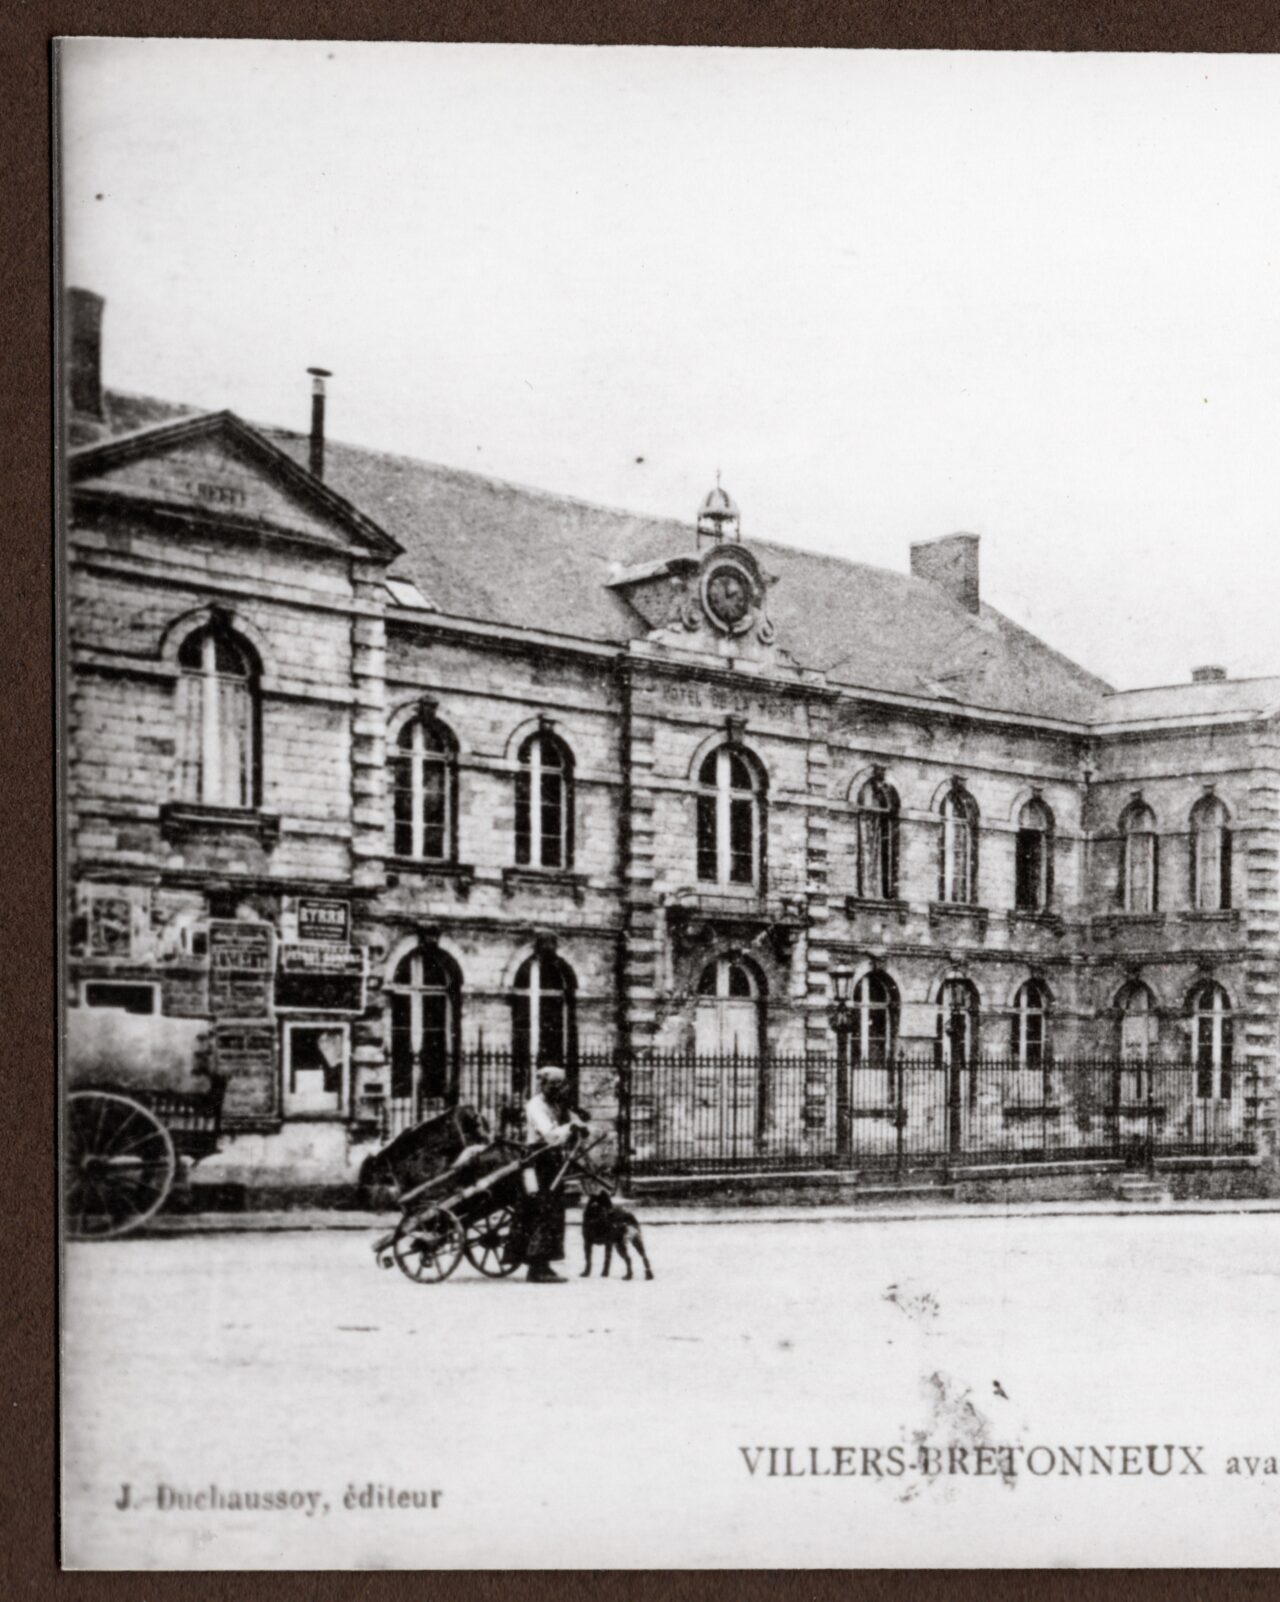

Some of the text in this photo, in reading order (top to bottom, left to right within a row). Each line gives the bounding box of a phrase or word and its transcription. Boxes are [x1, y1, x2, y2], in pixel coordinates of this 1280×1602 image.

[738, 1444, 1207, 1478] VILLERS-BRETONNEUX
[155, 1482, 331, 1517] Duchaussoy,
[342, 1482, 443, 1510] éditeur
